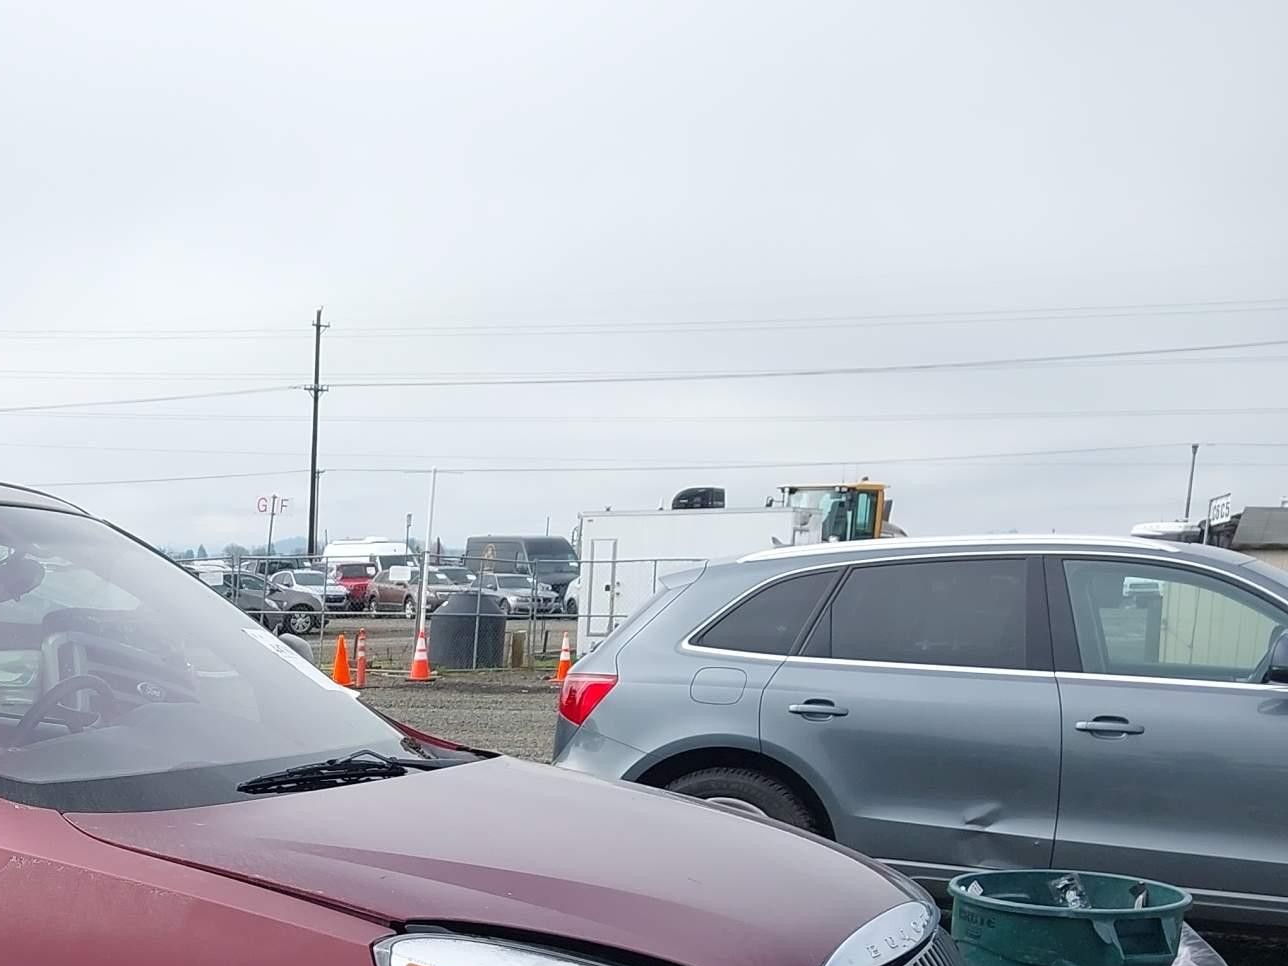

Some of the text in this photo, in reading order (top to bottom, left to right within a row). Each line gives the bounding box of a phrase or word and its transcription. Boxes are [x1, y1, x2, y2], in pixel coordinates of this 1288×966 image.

[257, 497, 268, 513] G
[280, 498, 290, 513] F
[865, 912, 931, 959] BUICK
